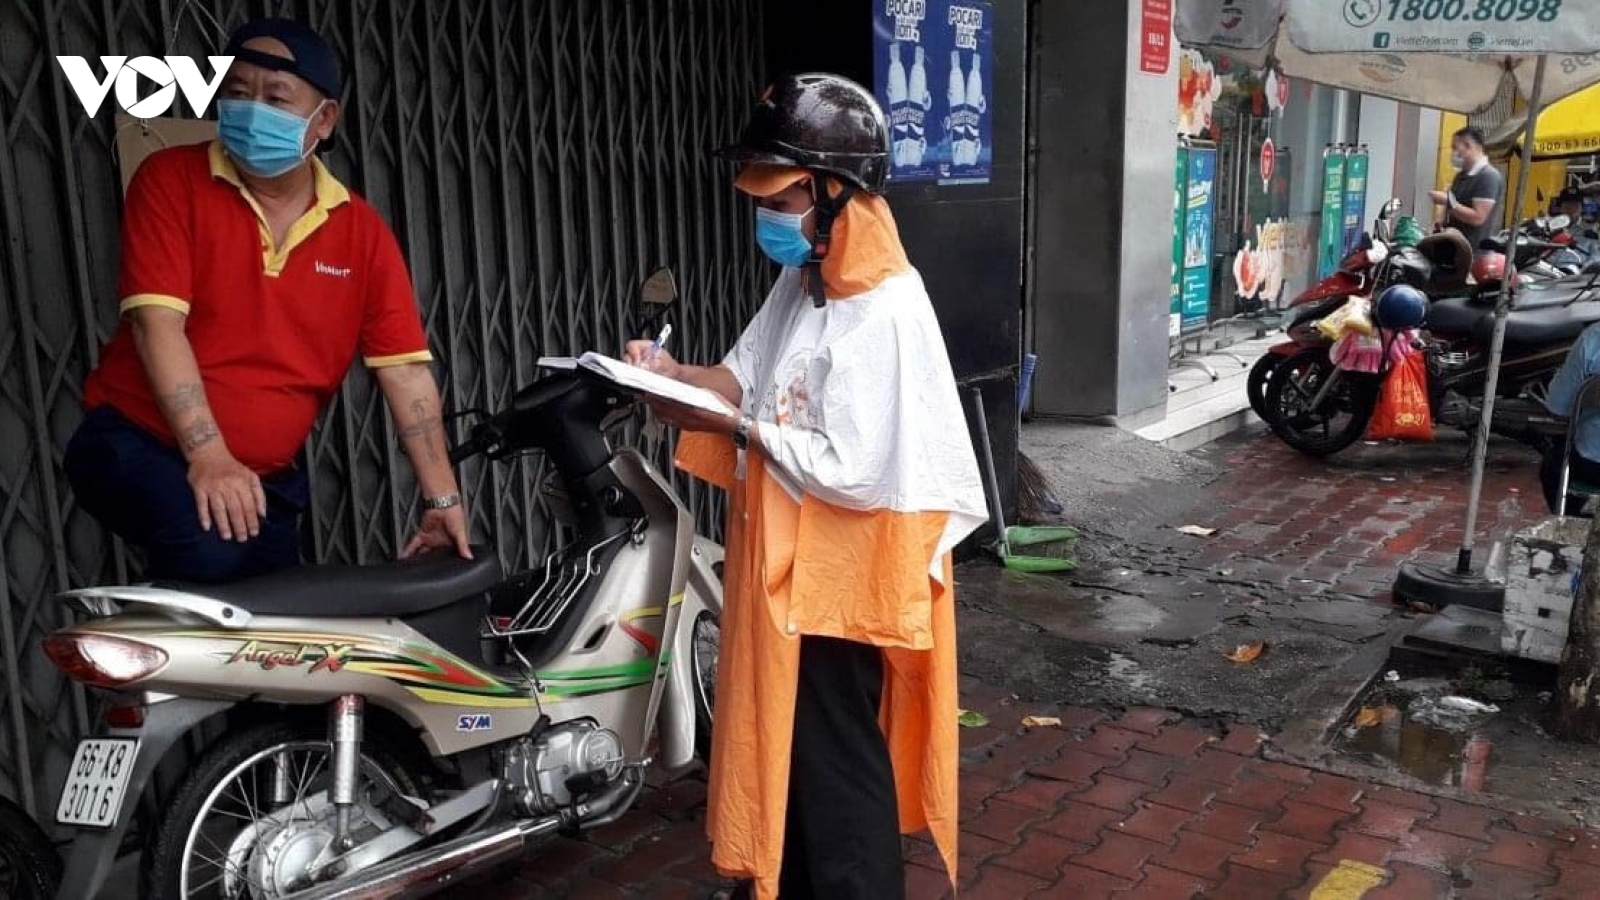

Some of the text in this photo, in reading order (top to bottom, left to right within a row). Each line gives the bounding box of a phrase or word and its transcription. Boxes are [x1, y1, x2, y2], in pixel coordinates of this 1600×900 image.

[886, 0, 925, 19] POCARI
[949, 7, 982, 28] POCARI
[1387, 0, 1561, 22] 1800.8098
[458, 714, 492, 731] SYM
[64, 783, 114, 822] 3016
